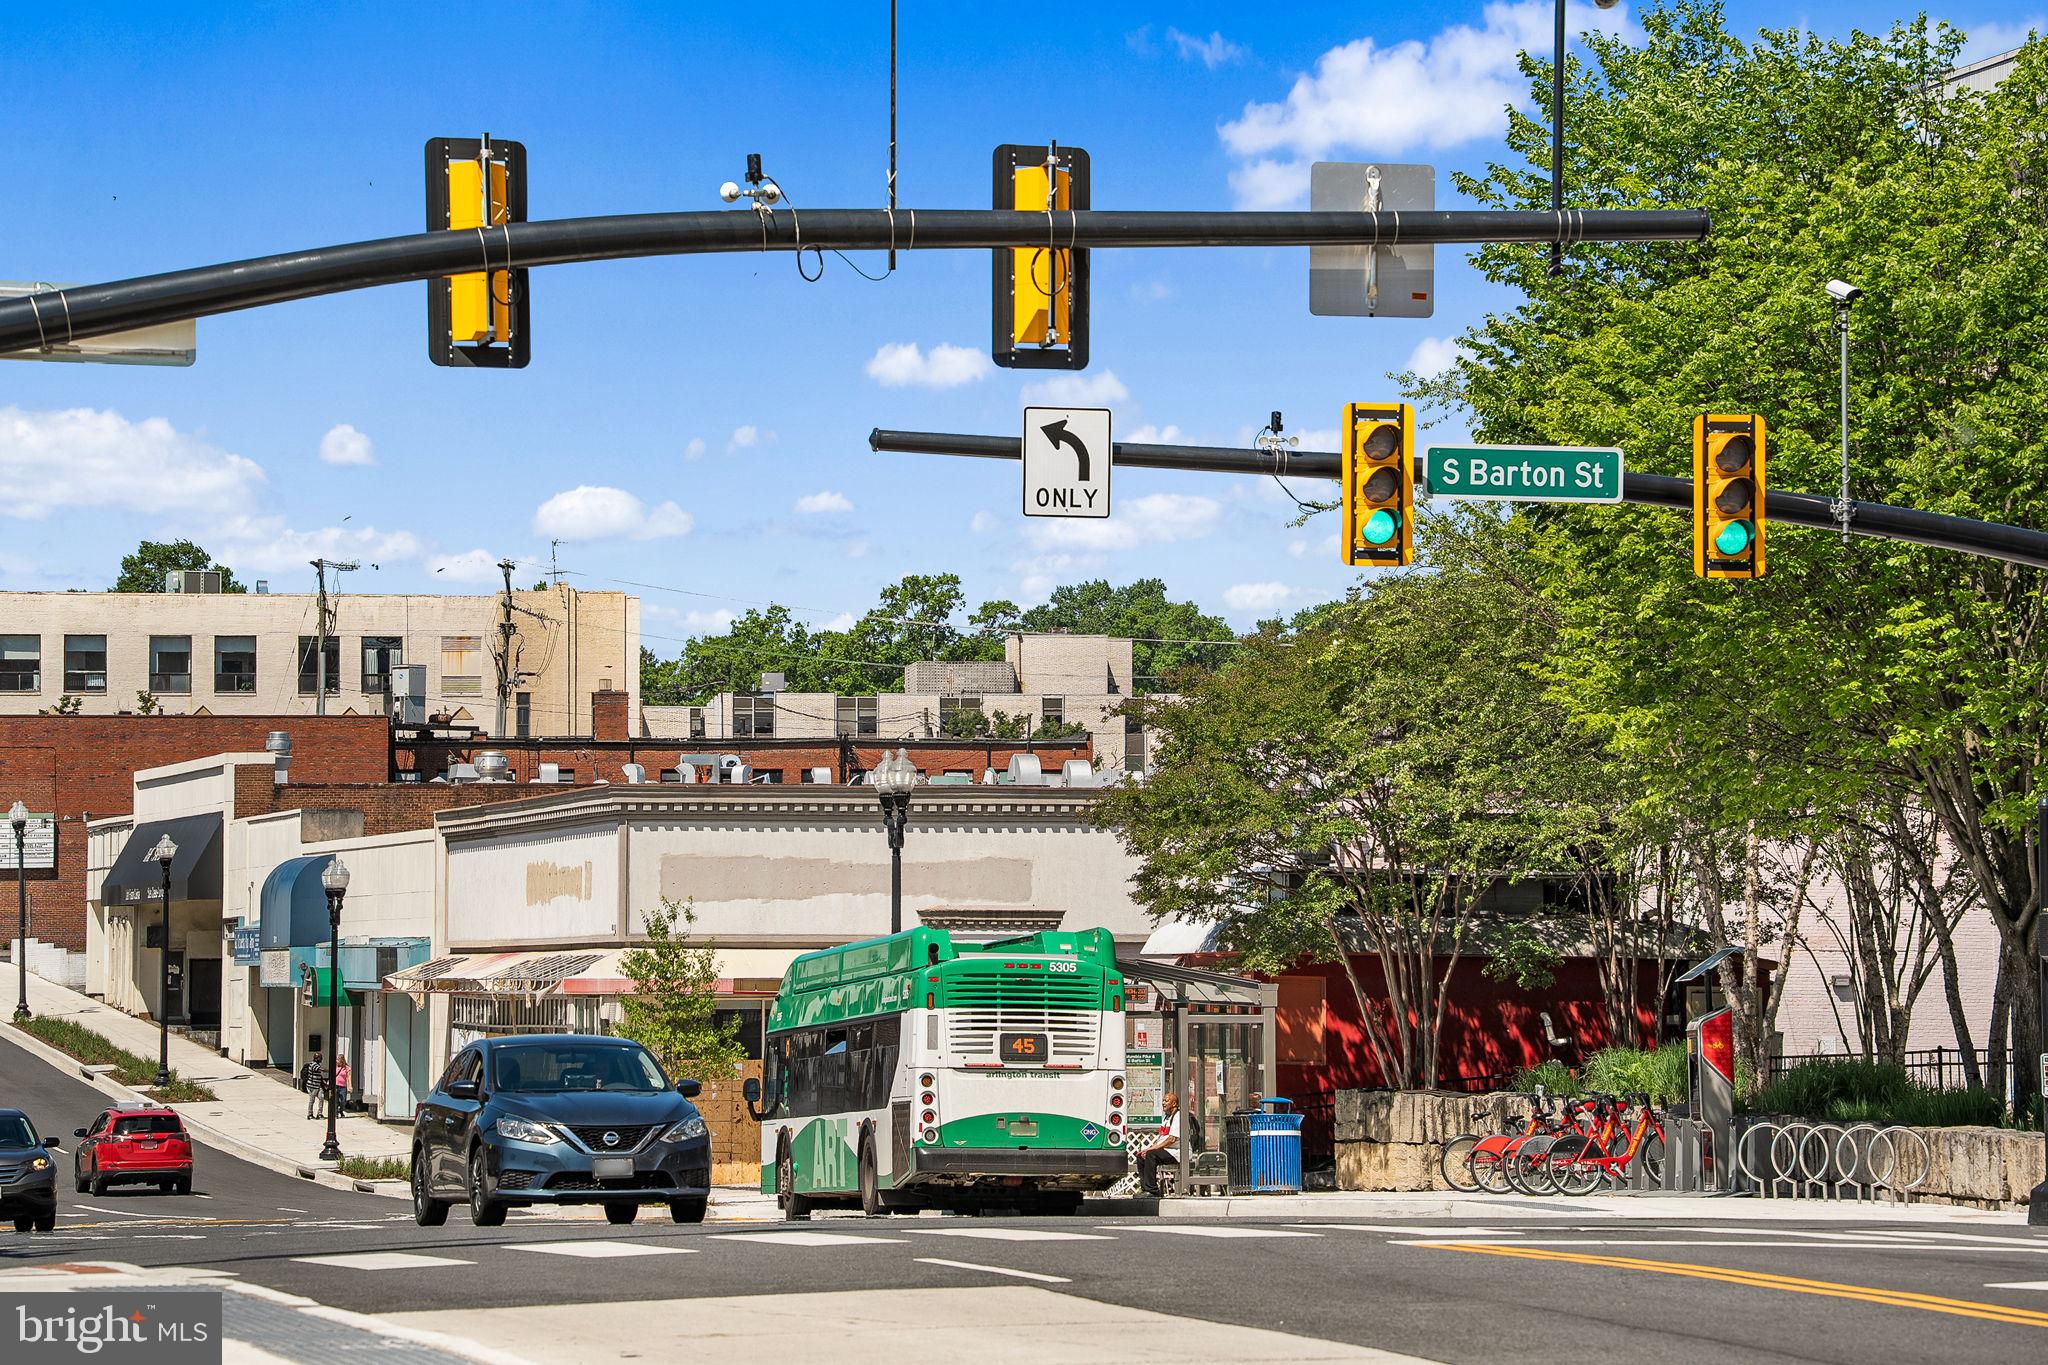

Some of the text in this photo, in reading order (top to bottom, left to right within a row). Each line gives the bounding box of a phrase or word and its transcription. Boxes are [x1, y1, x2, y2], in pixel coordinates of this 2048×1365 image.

[1442, 458, 1604, 489] S Barton St
[1036, 487, 1098, 509] ONLY
[1049, 962, 1077, 972] 5305
[1012, 1038, 1035, 1054] 45
[986, 1070, 1061, 1079] arlington transit
[812, 1118, 848, 1189] ART
